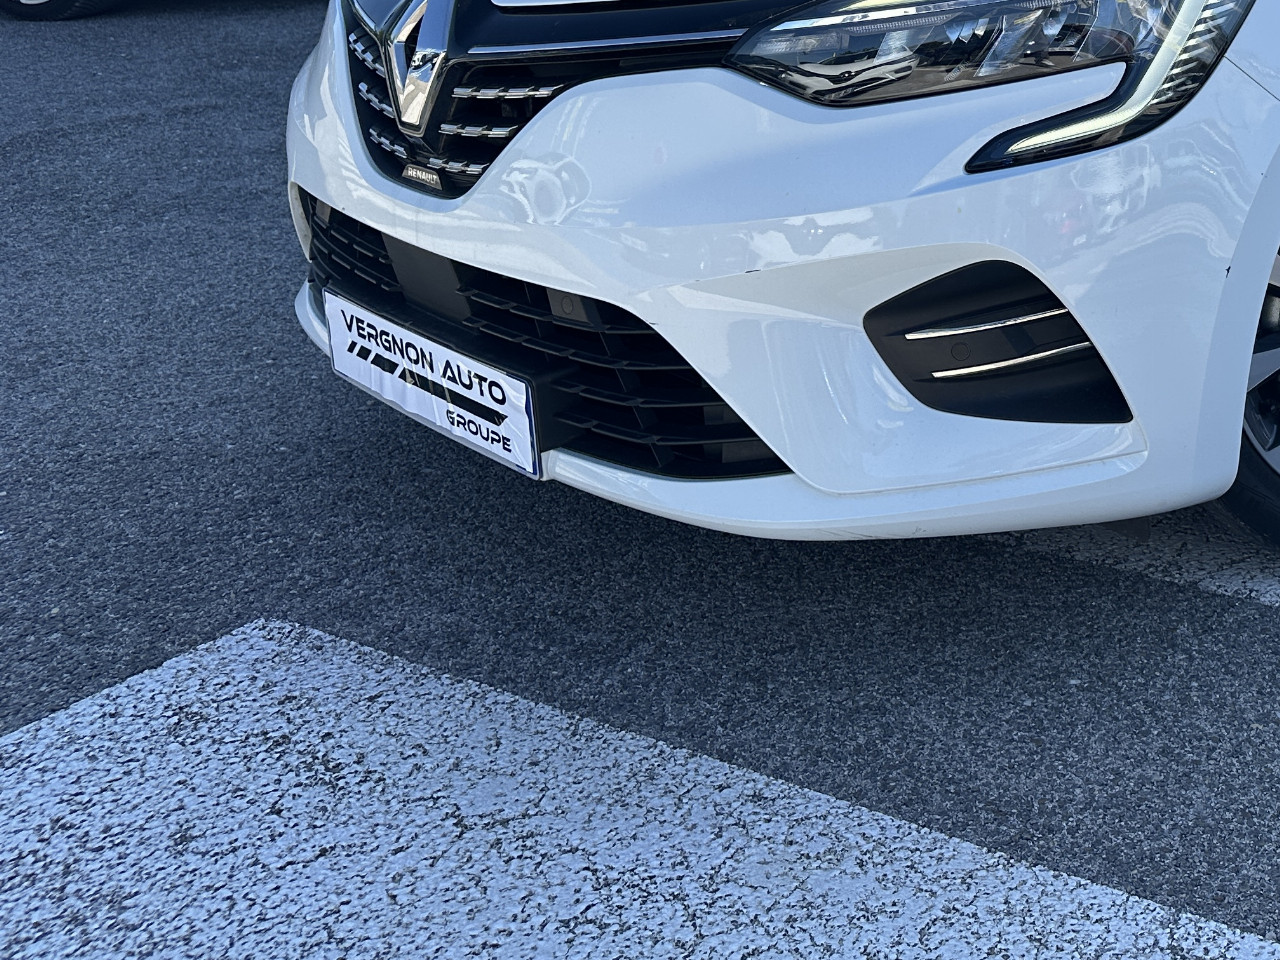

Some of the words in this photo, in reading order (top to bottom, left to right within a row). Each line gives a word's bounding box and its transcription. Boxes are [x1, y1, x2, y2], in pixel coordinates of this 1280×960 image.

[407, 166, 438, 184] RENAULT
[341, 309, 435, 374] VERGNON
[441, 359, 507, 406] AUTO
[446, 409, 512, 453] GROUPE
